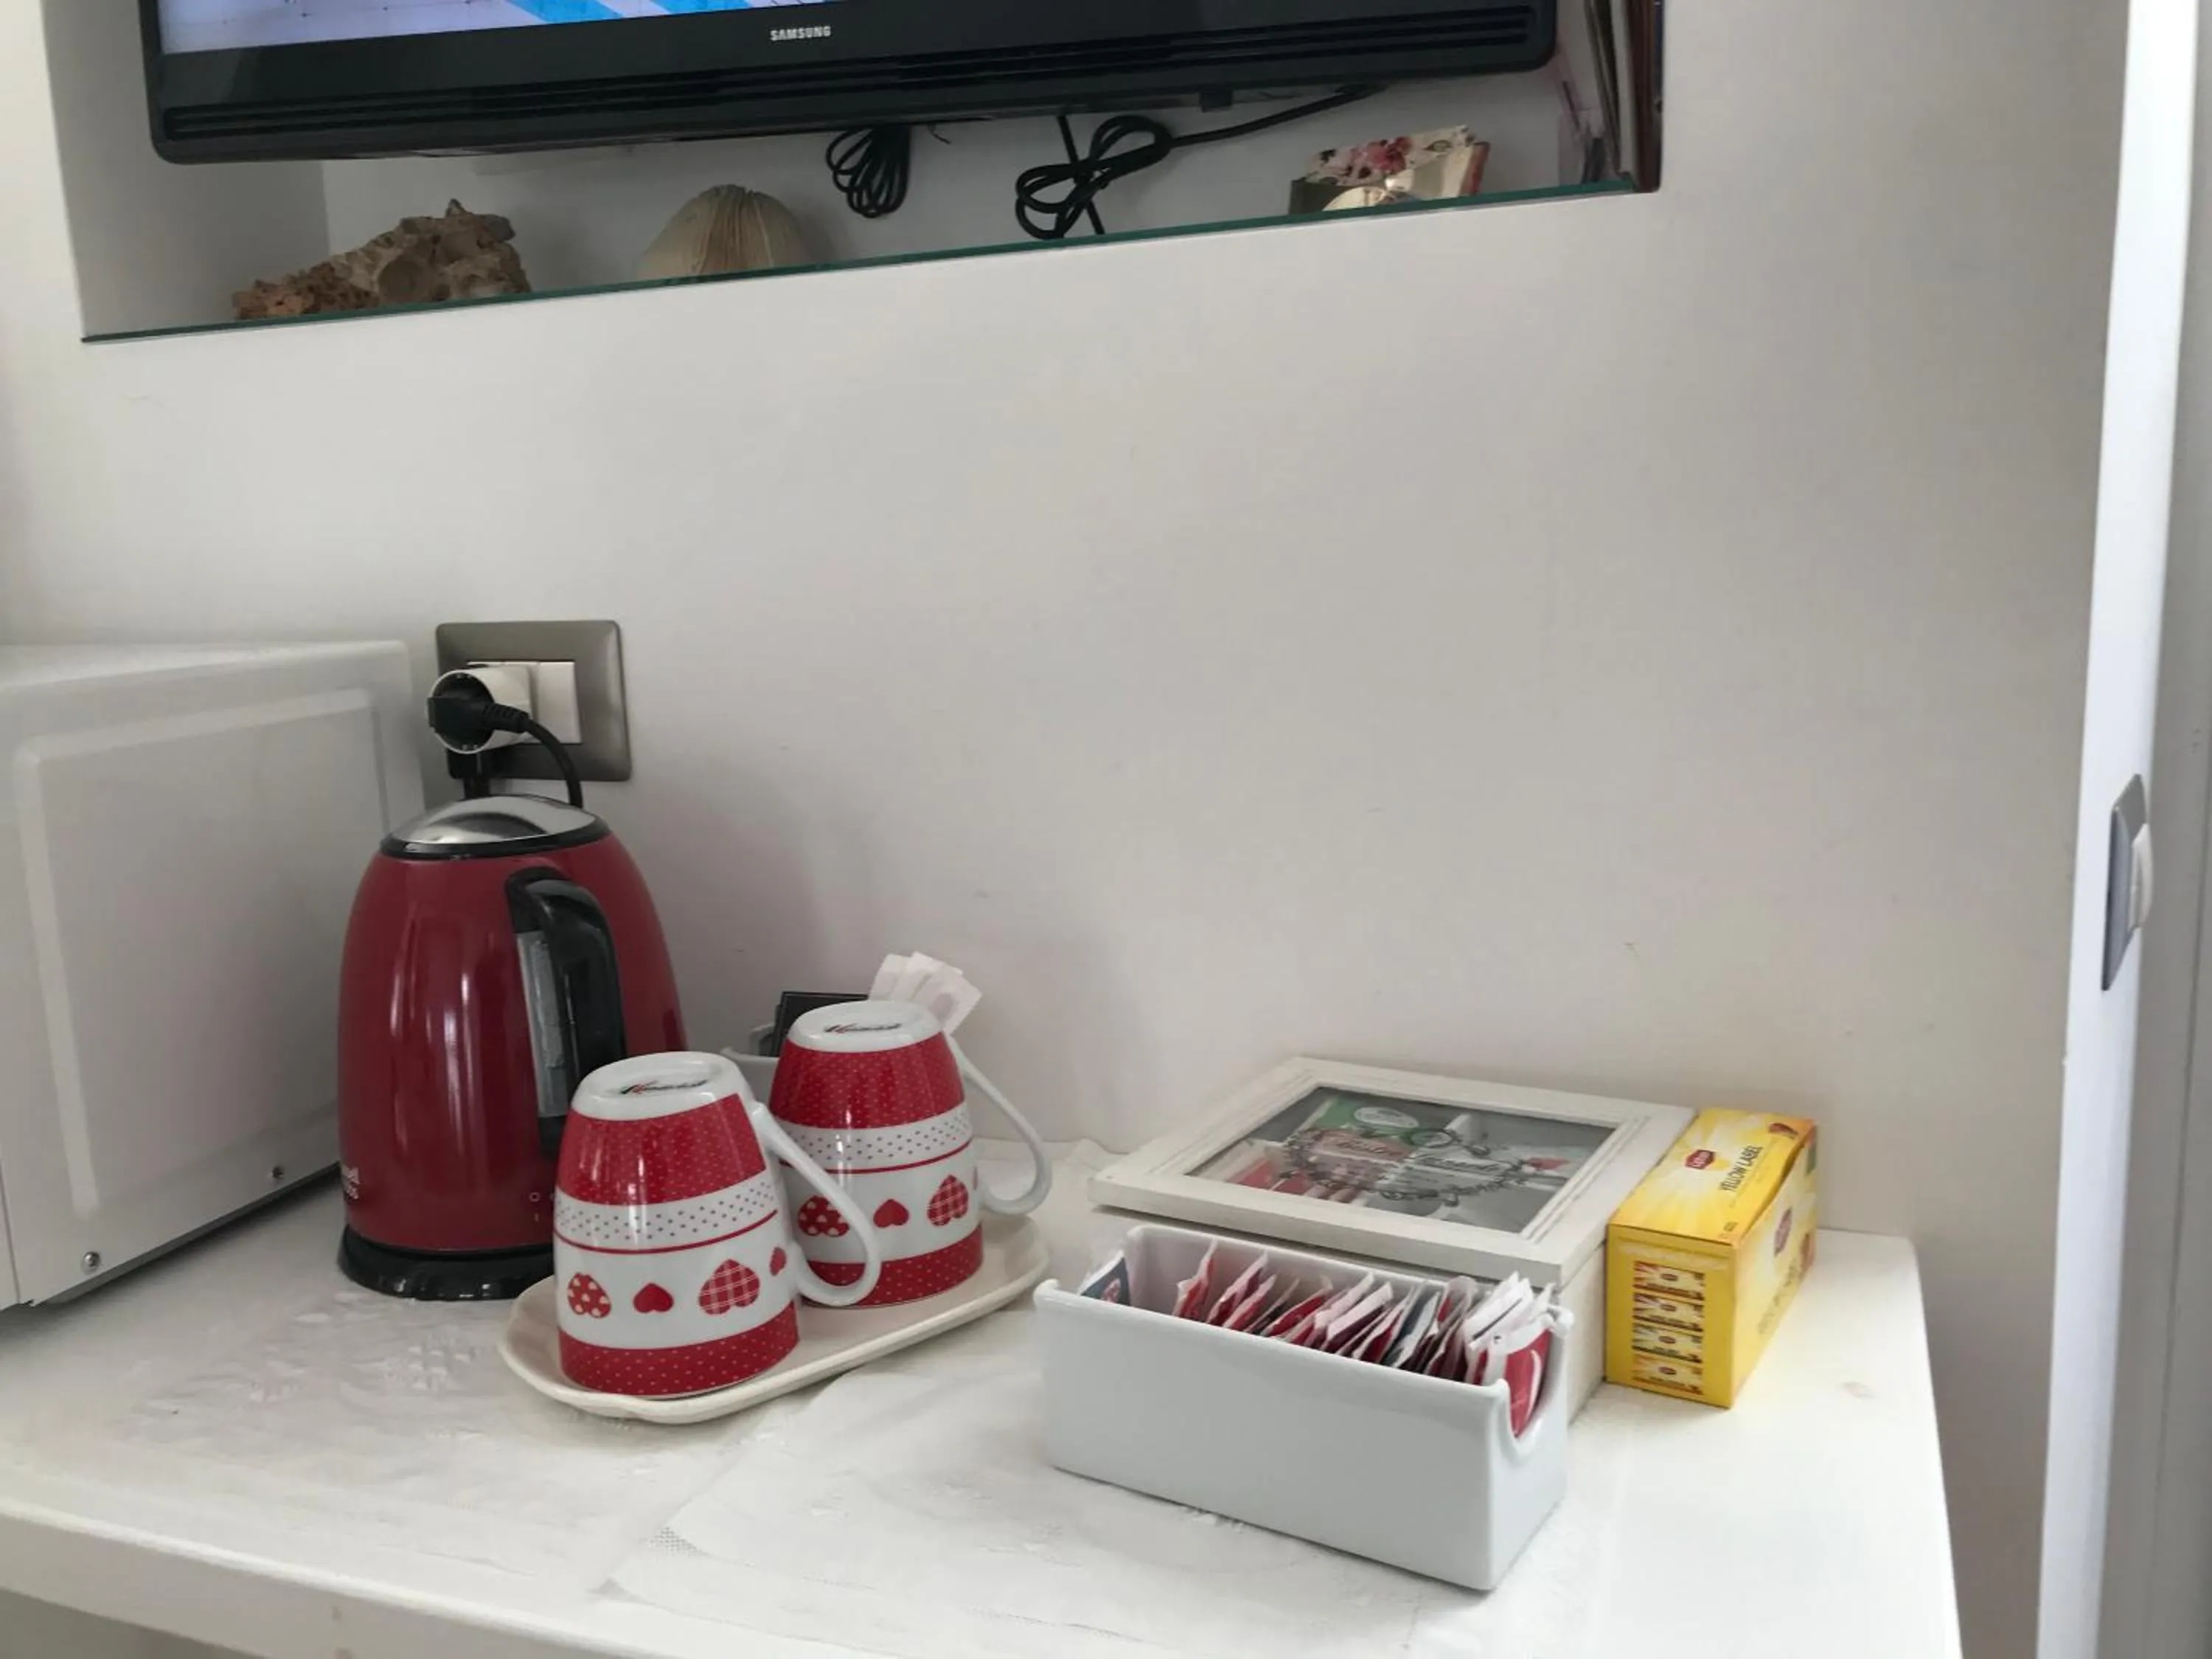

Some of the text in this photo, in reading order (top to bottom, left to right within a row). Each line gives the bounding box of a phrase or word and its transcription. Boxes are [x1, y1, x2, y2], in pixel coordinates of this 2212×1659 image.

[770, 26, 831, 41] SAMSUNG
[1719, 1164, 1747, 1192] YELLOW
[1736, 1145, 1763, 1167] LABEL
